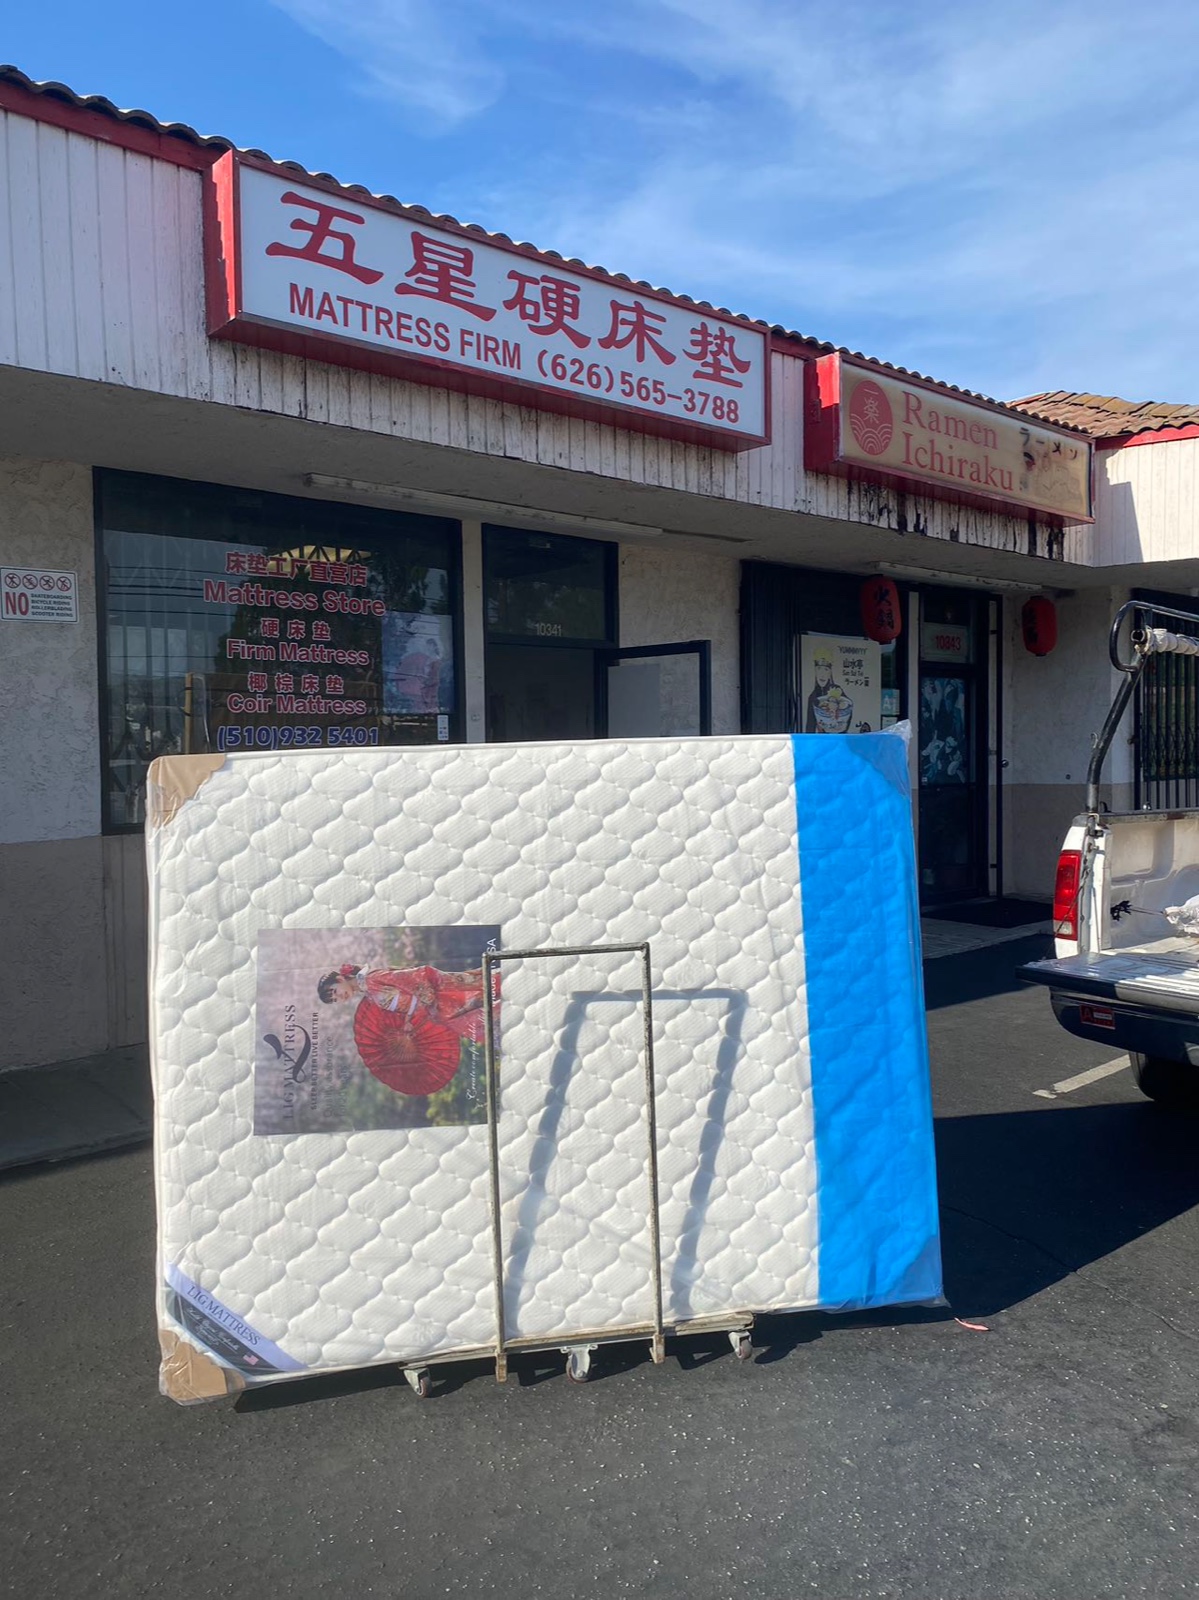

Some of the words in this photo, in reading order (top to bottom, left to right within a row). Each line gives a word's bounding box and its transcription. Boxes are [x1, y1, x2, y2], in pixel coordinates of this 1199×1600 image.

[265, 191, 752, 389] 五星硬床垫
[288, 282, 451, 353] MATTRESS
[459, 329, 522, 371] FIRM
[901, 390, 999, 450] Ramen
[901, 431, 1014, 492] Ichiraku
[225, 551, 368, 587] 床垫工厂直营店
[5, 591, 29, 616] NO
[203, 579, 319, 612] Mattress
[323, 590, 386, 616] Store
[260, 618, 331, 640] 硬床垫
[534, 622, 562, 637] 10341
[226, 639, 275, 661] Firm
[279, 642, 369, 665] Mattress
[248, 672, 344, 694] 椰棕床垫
[227, 693, 272, 713] Coir
[276, 695, 367, 715] Mattress
[217, 726, 323, 750] (510)932
[327, 726, 379, 745] 5401
[311, 1012, 319, 1040] BETTER
[283, 1004, 296, 1089] MATTRESS
[311, 1041, 319, 1057] LIVE
[310, 1059, 318, 1086] BETTER
[283, 1091, 294, 1121] LIG
[310, 1088, 318, 1110] SLEEP
[186, 1285, 209, 1305] LIG
[206, 1299, 261, 1346] MATTRESS
